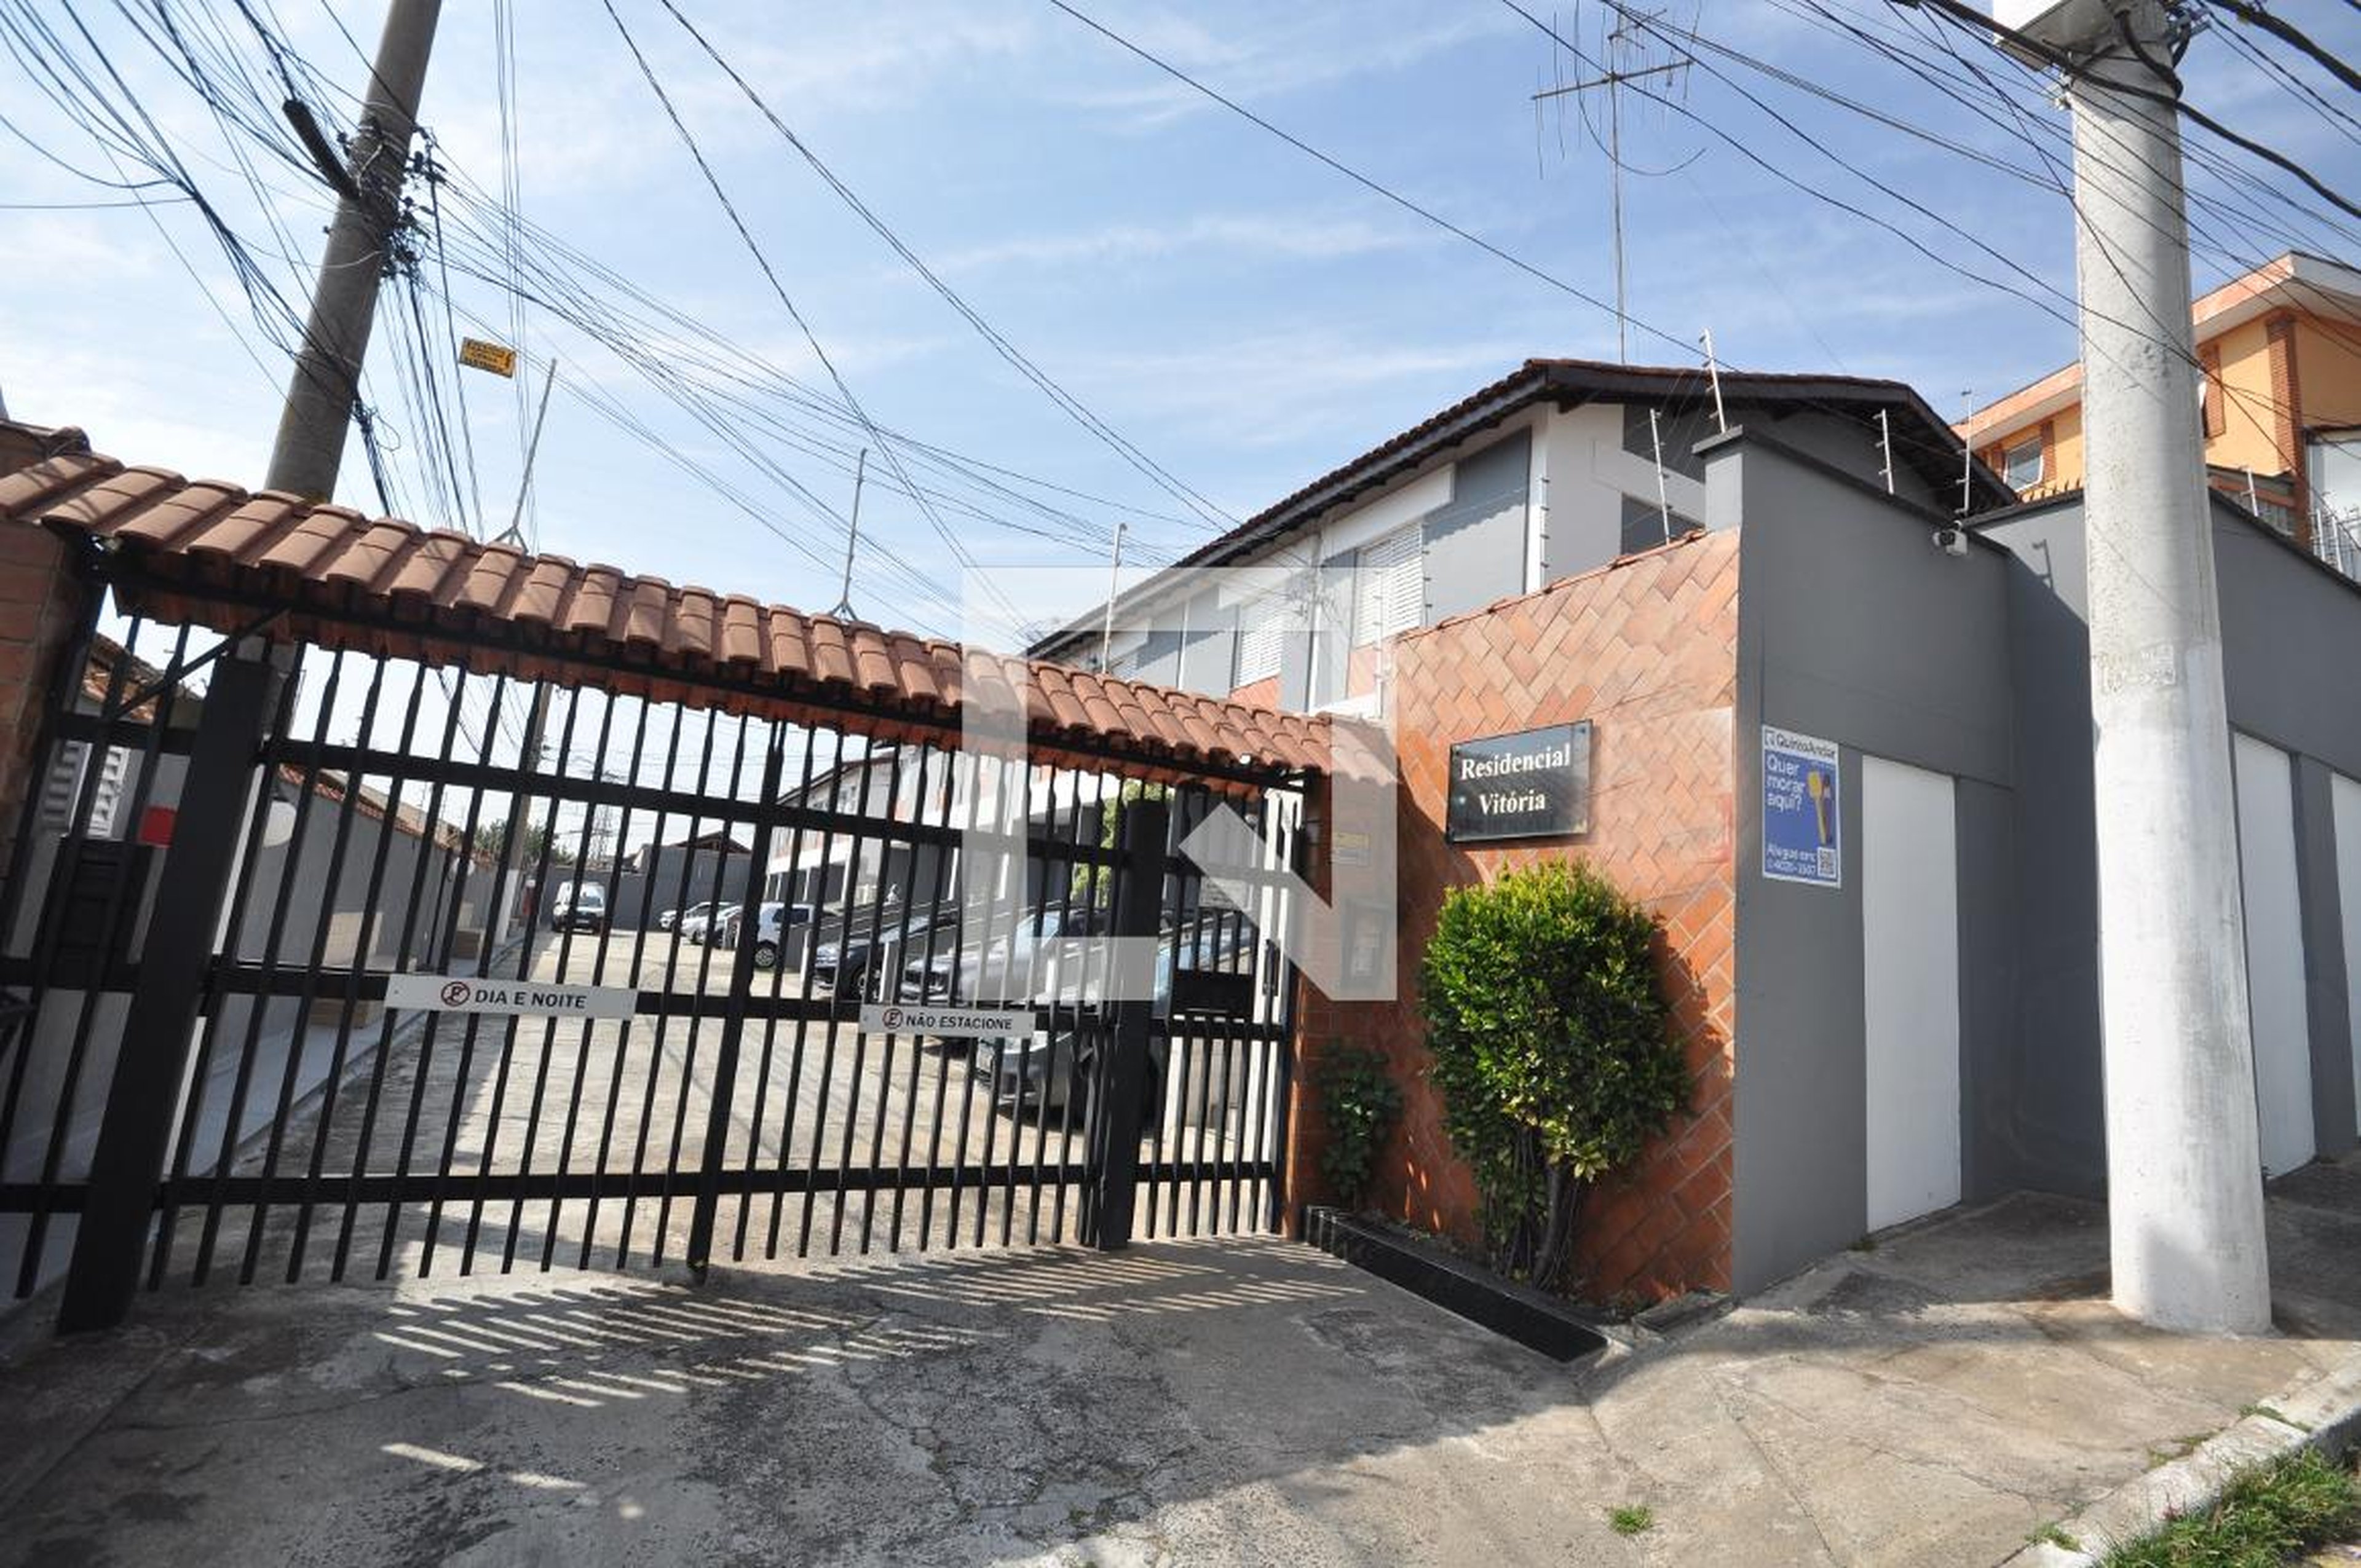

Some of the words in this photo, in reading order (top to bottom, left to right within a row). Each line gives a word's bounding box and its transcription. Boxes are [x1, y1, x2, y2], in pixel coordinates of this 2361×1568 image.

[1460, 743, 1571, 781] Residencial
[1766, 754, 1800, 775] Quer
[1479, 789, 1546, 816] Vitória
[1766, 791, 1802, 813] aqui?
[475, 988, 508, 1005] DIA
[514, 991, 526, 1006] E
[531, 992, 587, 1009] NOITE
[906, 1012, 936, 1028] NÃO
[939, 1015, 1013, 1030] ESTACIONE
